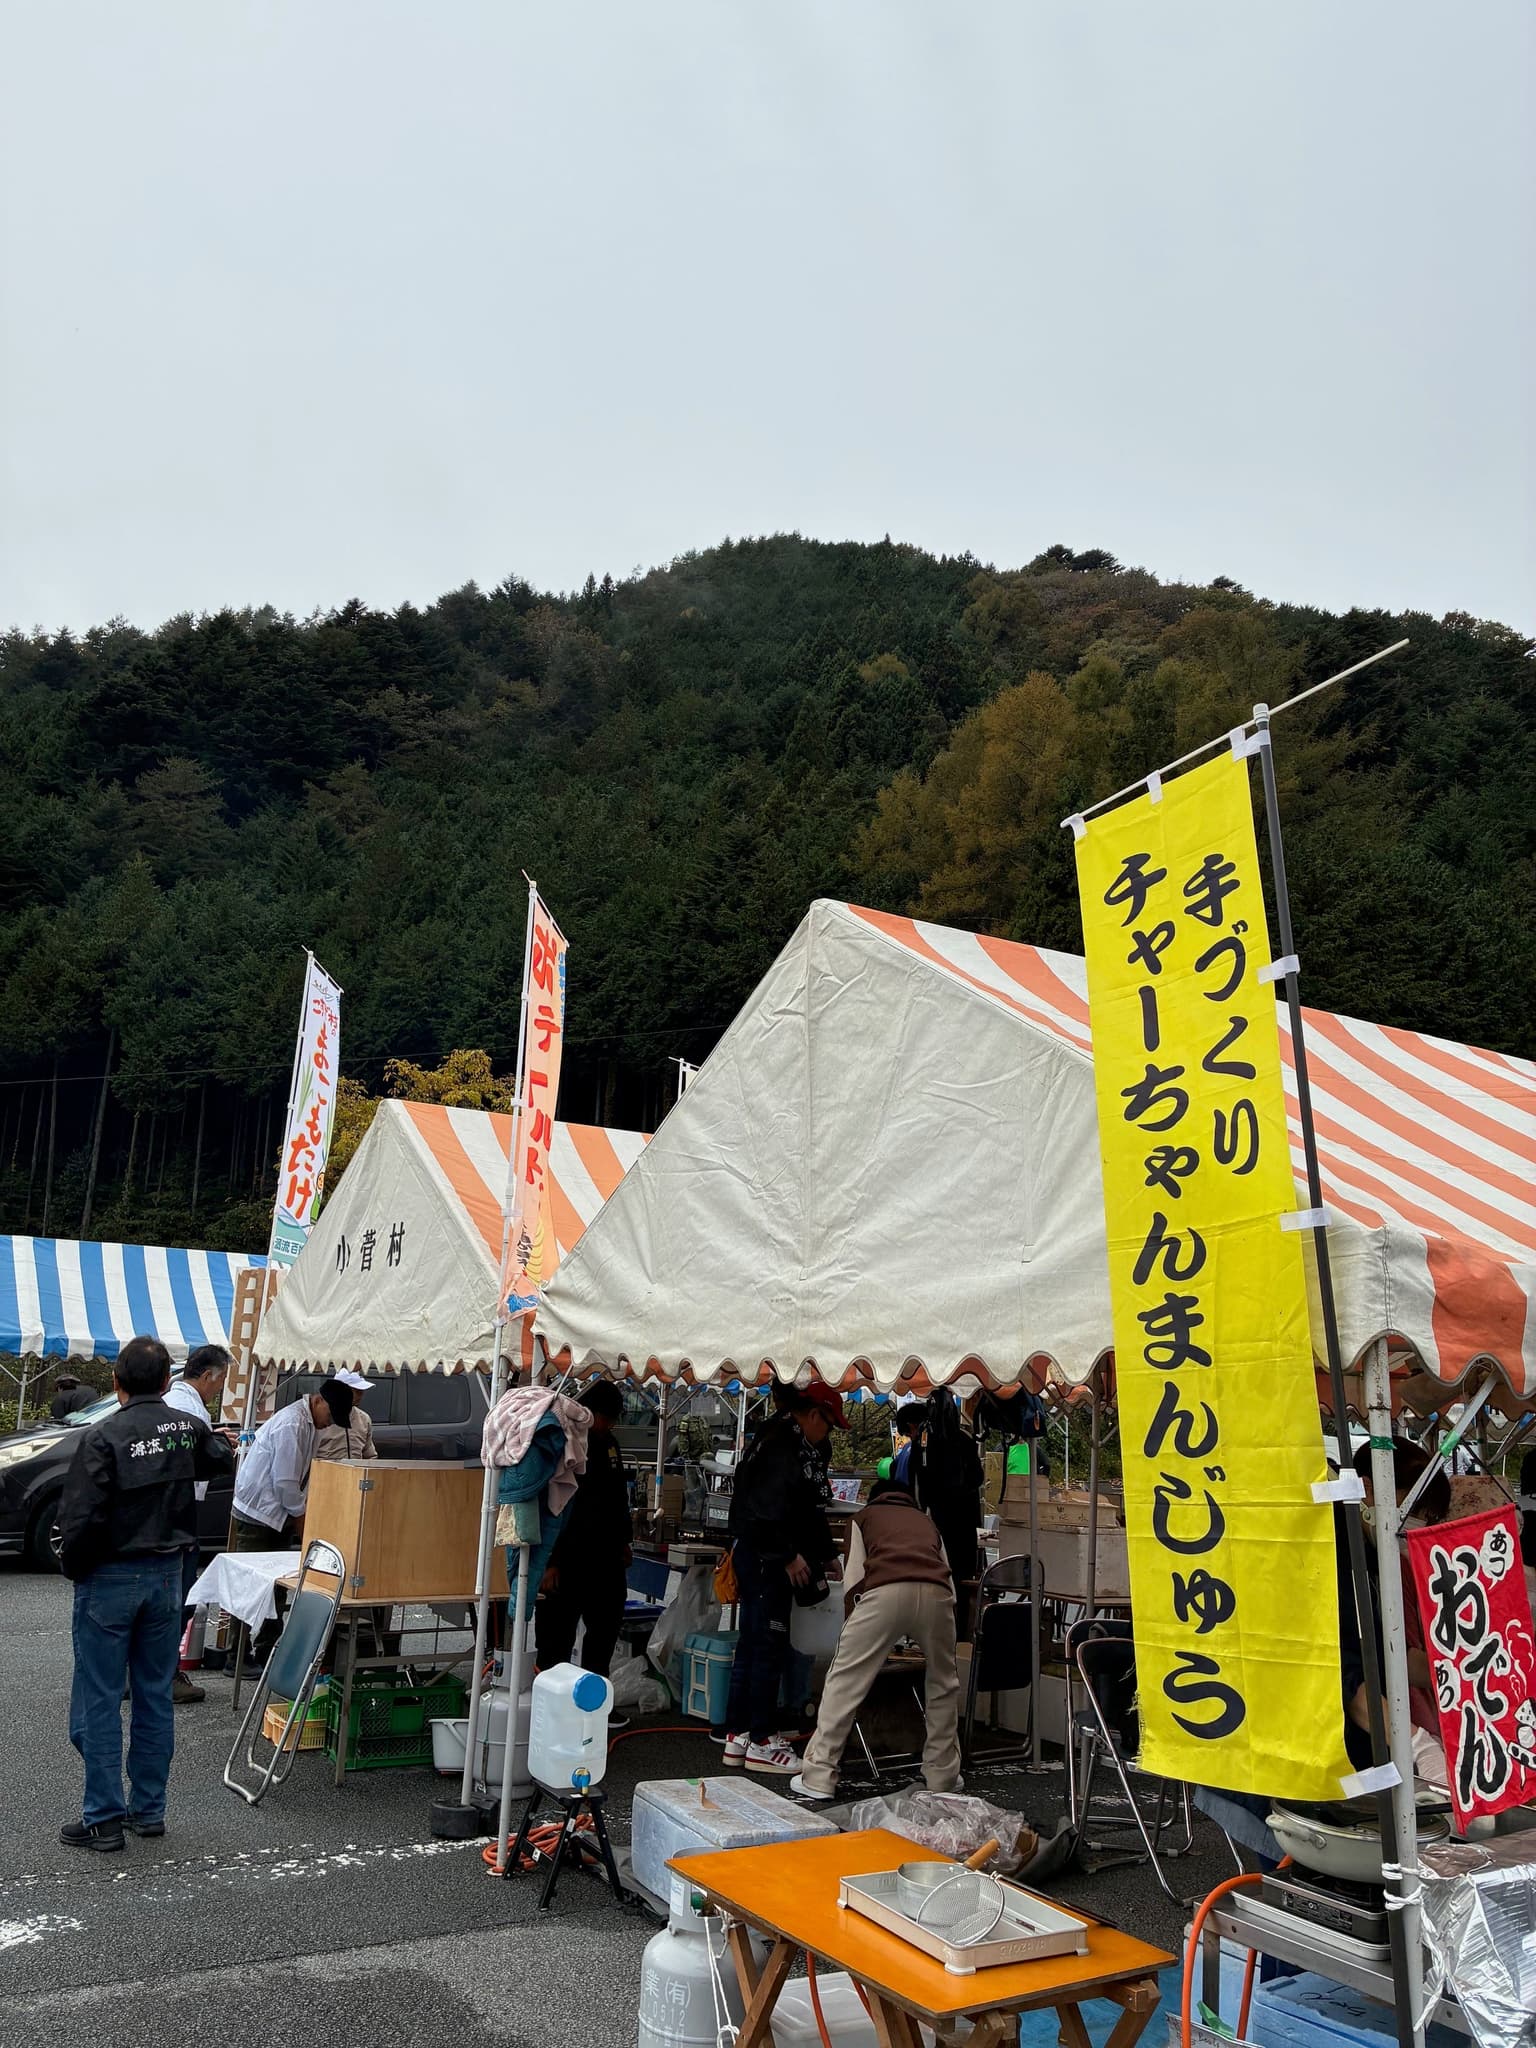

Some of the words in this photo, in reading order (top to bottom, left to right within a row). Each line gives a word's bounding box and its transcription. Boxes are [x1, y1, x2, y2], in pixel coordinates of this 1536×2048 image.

[1183, 853, 1260, 1175] 手づくり
[336, 1221, 406, 1275] 小菅村
[1104, 853, 1246, 1740] チャーちゃんまんじゅう
[156, 1422, 177, 1434] NPO
[178, 1420, 194, 1431] 法人
[1490, 1530, 1507, 1577] あつ
[1431, 1550, 1507, 1805] おでん
